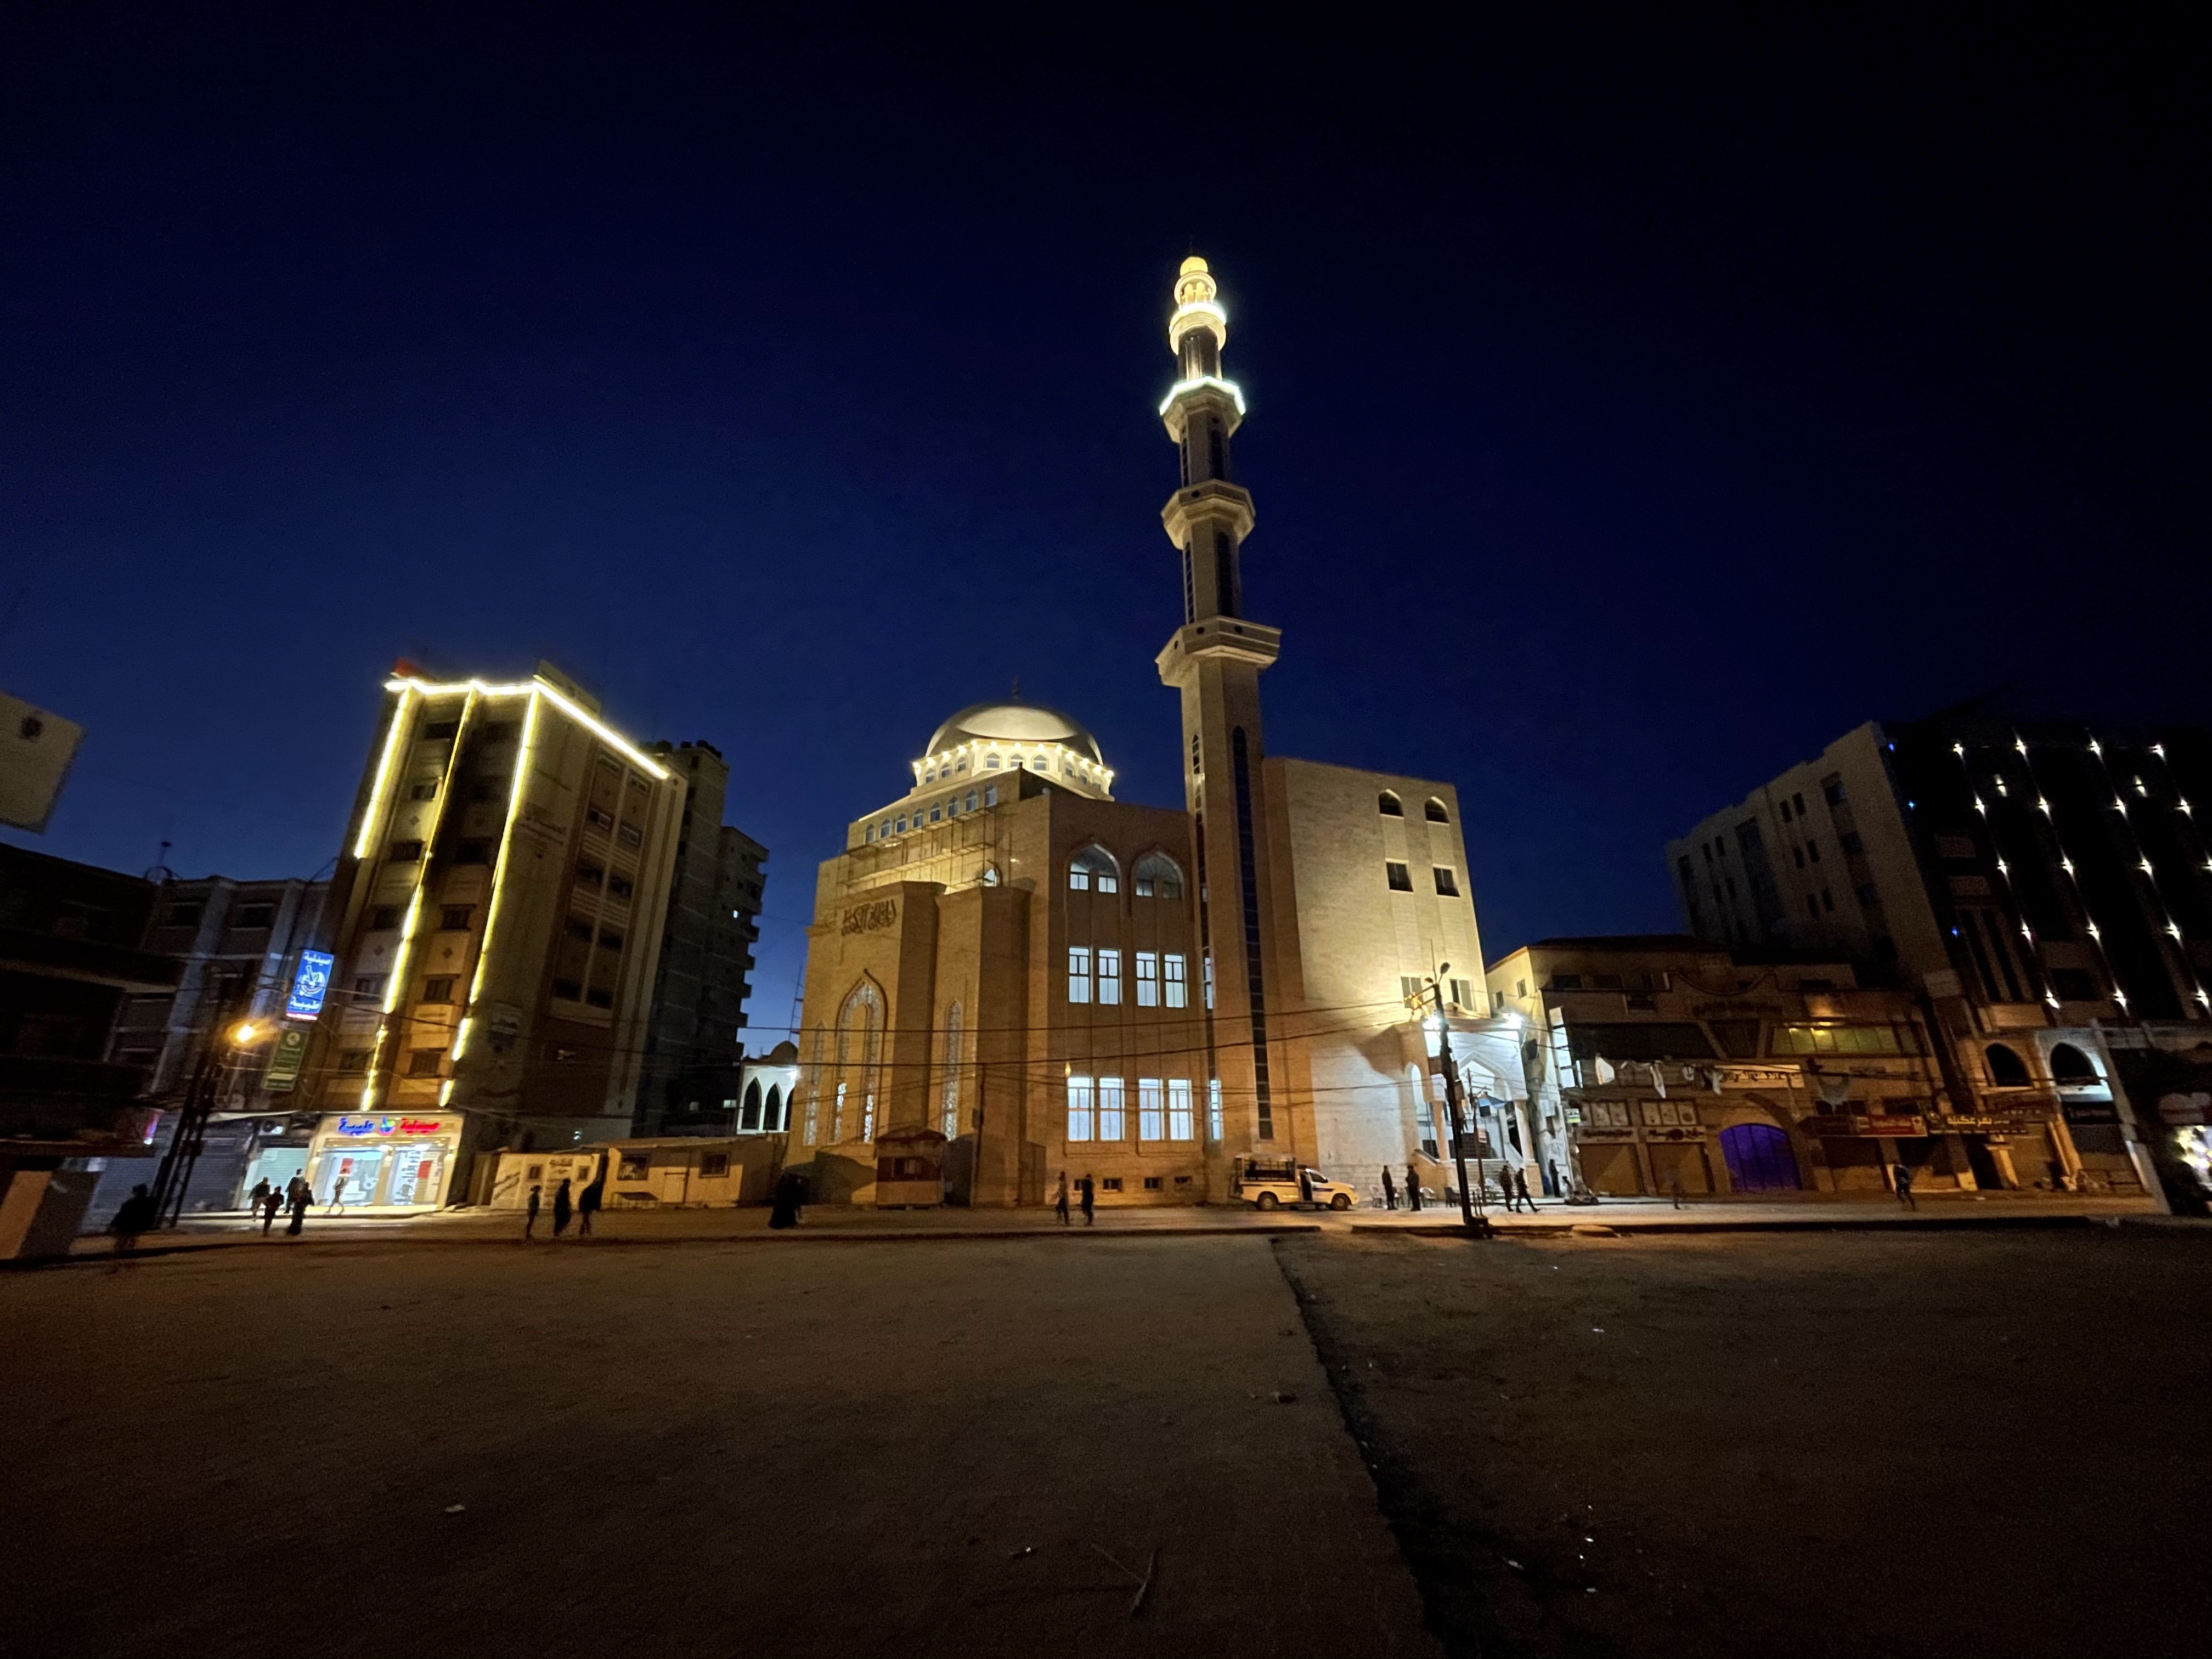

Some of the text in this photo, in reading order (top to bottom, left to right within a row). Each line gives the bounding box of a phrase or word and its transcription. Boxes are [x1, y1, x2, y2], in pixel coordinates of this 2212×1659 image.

[303, 952, 331, 966] صيدلية
[338, 1118, 441, 1136] صيدلية طيبة
